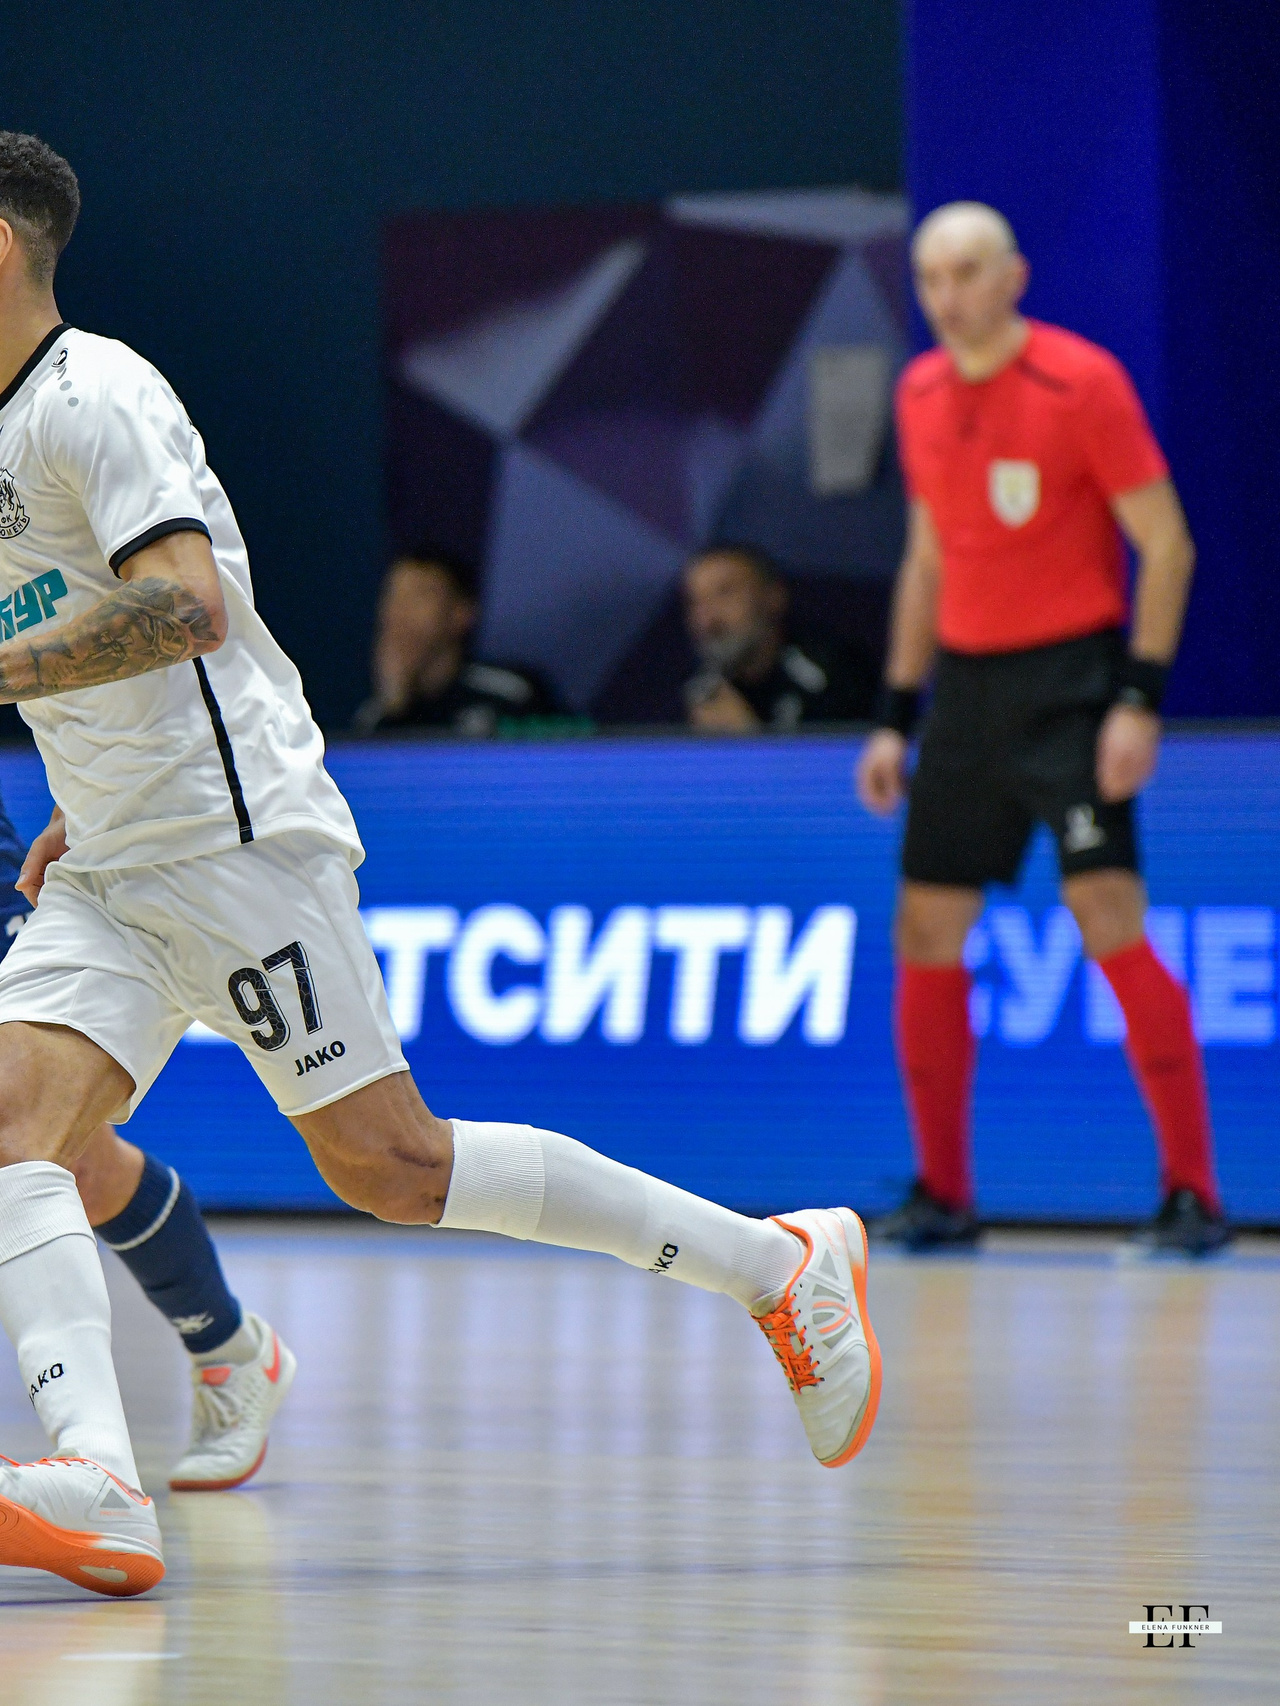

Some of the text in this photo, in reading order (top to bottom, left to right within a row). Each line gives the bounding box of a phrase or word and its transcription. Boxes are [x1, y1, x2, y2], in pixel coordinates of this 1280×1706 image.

[183, 904, 856, 1045] ТСИТИ
[228, 941, 323, 1051] 97
[294, 1040, 346, 1077] JAKO
[648, 1243, 679, 1273] AKO
